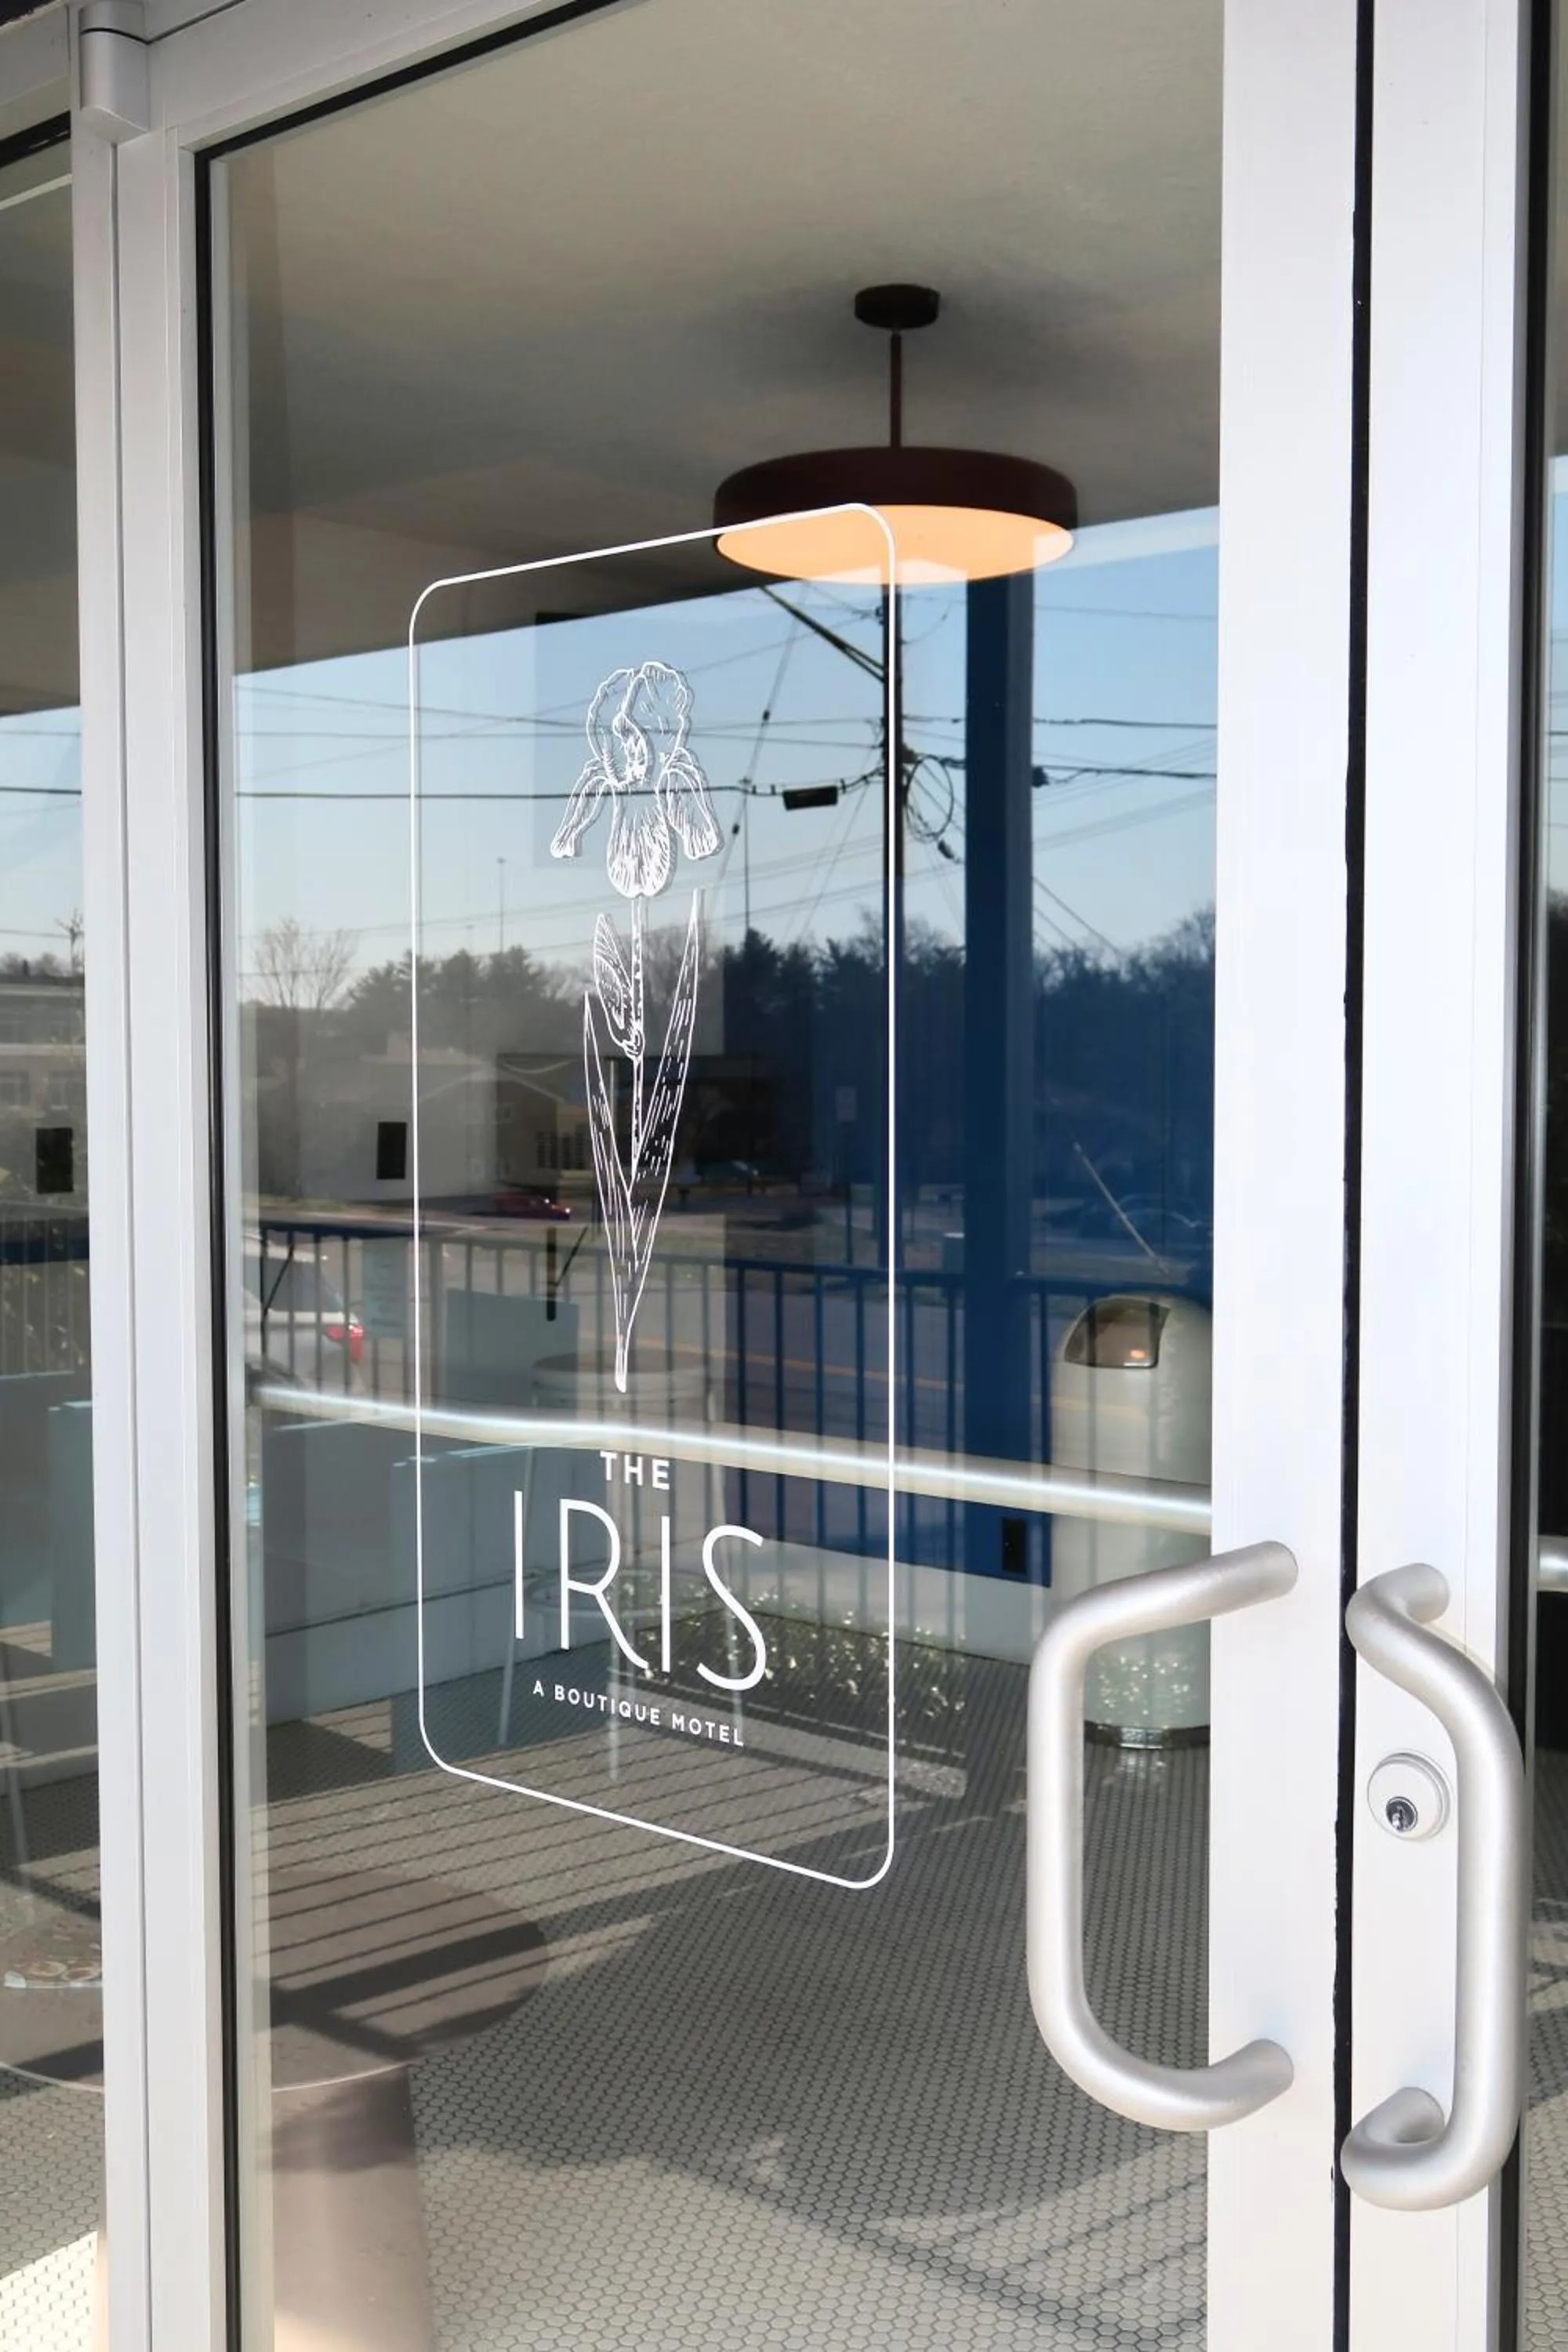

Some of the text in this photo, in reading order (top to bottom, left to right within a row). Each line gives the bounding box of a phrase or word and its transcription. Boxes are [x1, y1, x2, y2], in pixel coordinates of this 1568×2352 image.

[600, 1452, 670, 1490] THE
[514, 1490, 766, 1691] IRIS
[532, 1680, 744, 1747] A BOUTIQUE MOTEL
